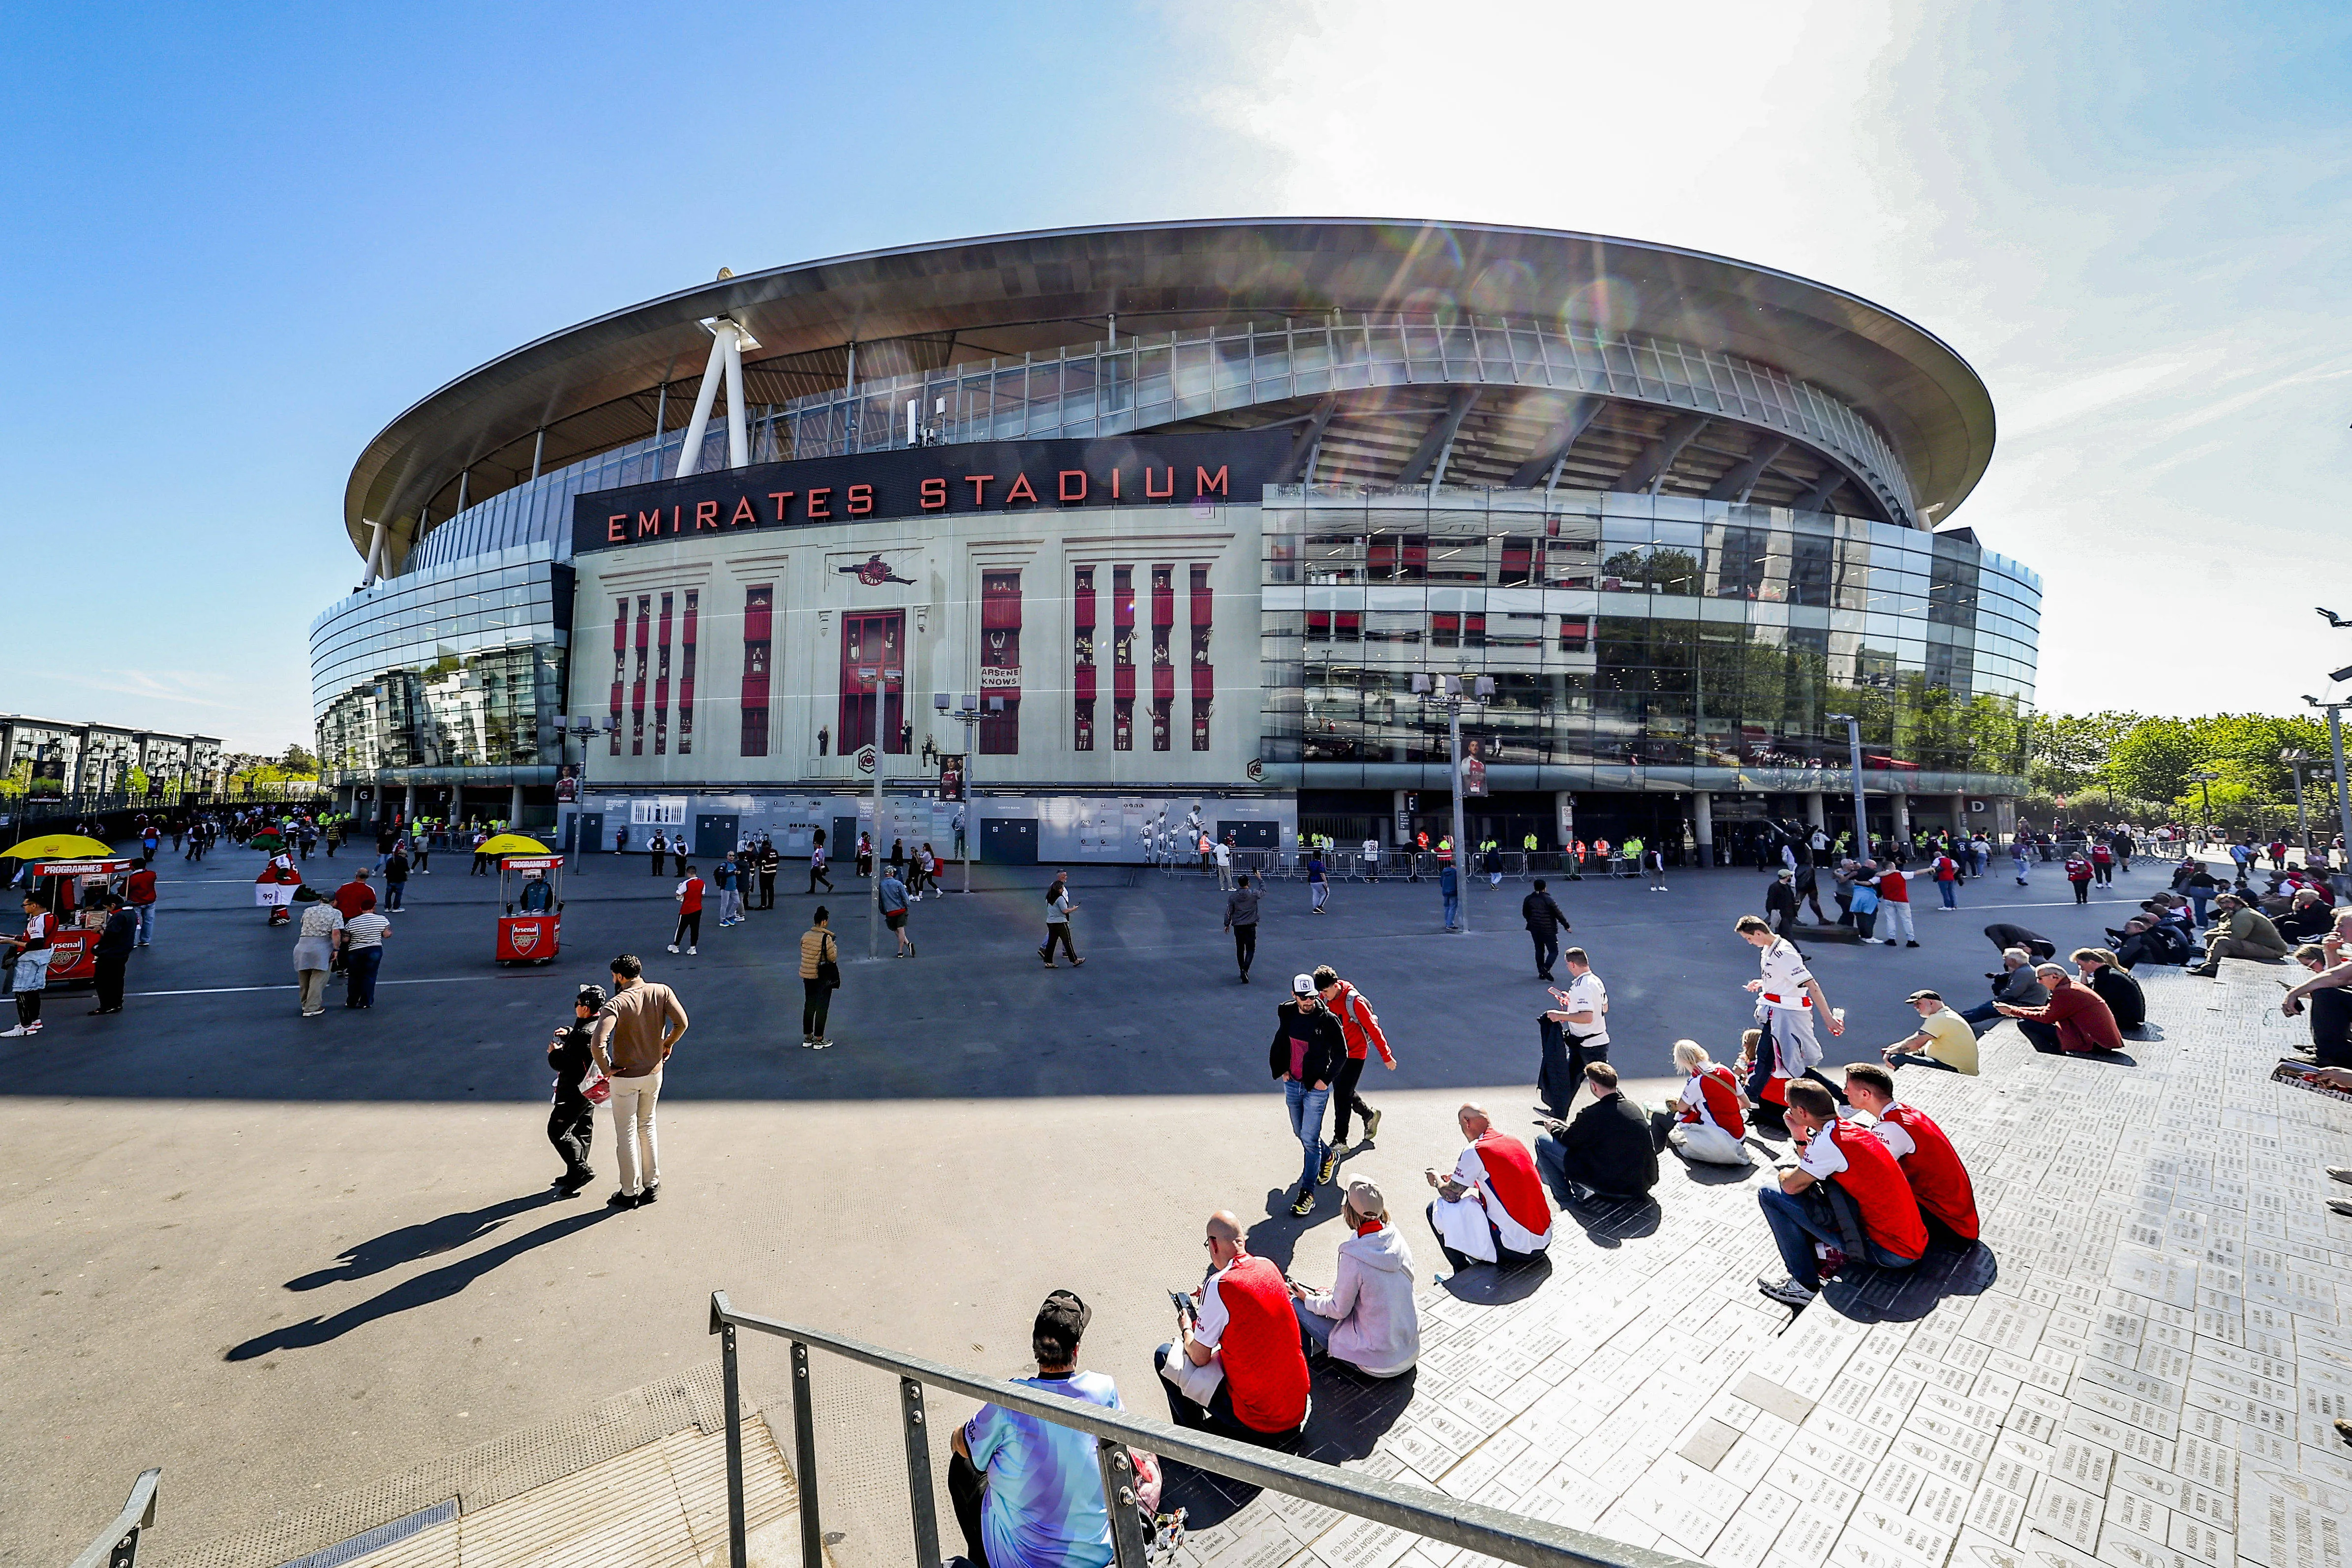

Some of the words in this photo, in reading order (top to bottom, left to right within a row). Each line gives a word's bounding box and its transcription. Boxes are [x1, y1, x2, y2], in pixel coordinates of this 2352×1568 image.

[609, 484, 873, 542] EMIRATES
[920, 465, 1228, 509] STADIUM
[439, 791, 445, 801] F
[1409, 797, 1414, 810] E
[1971, 801, 1985, 812] D
[44, 864, 102, 874] PROGRAMMES
[509, 860, 551, 869] PROGRAMMES
[1349, 1531, 1360, 1540] AT
[1338, 1536, 1354, 1549] THE
[1341, 1546, 1362, 1563] FROM
